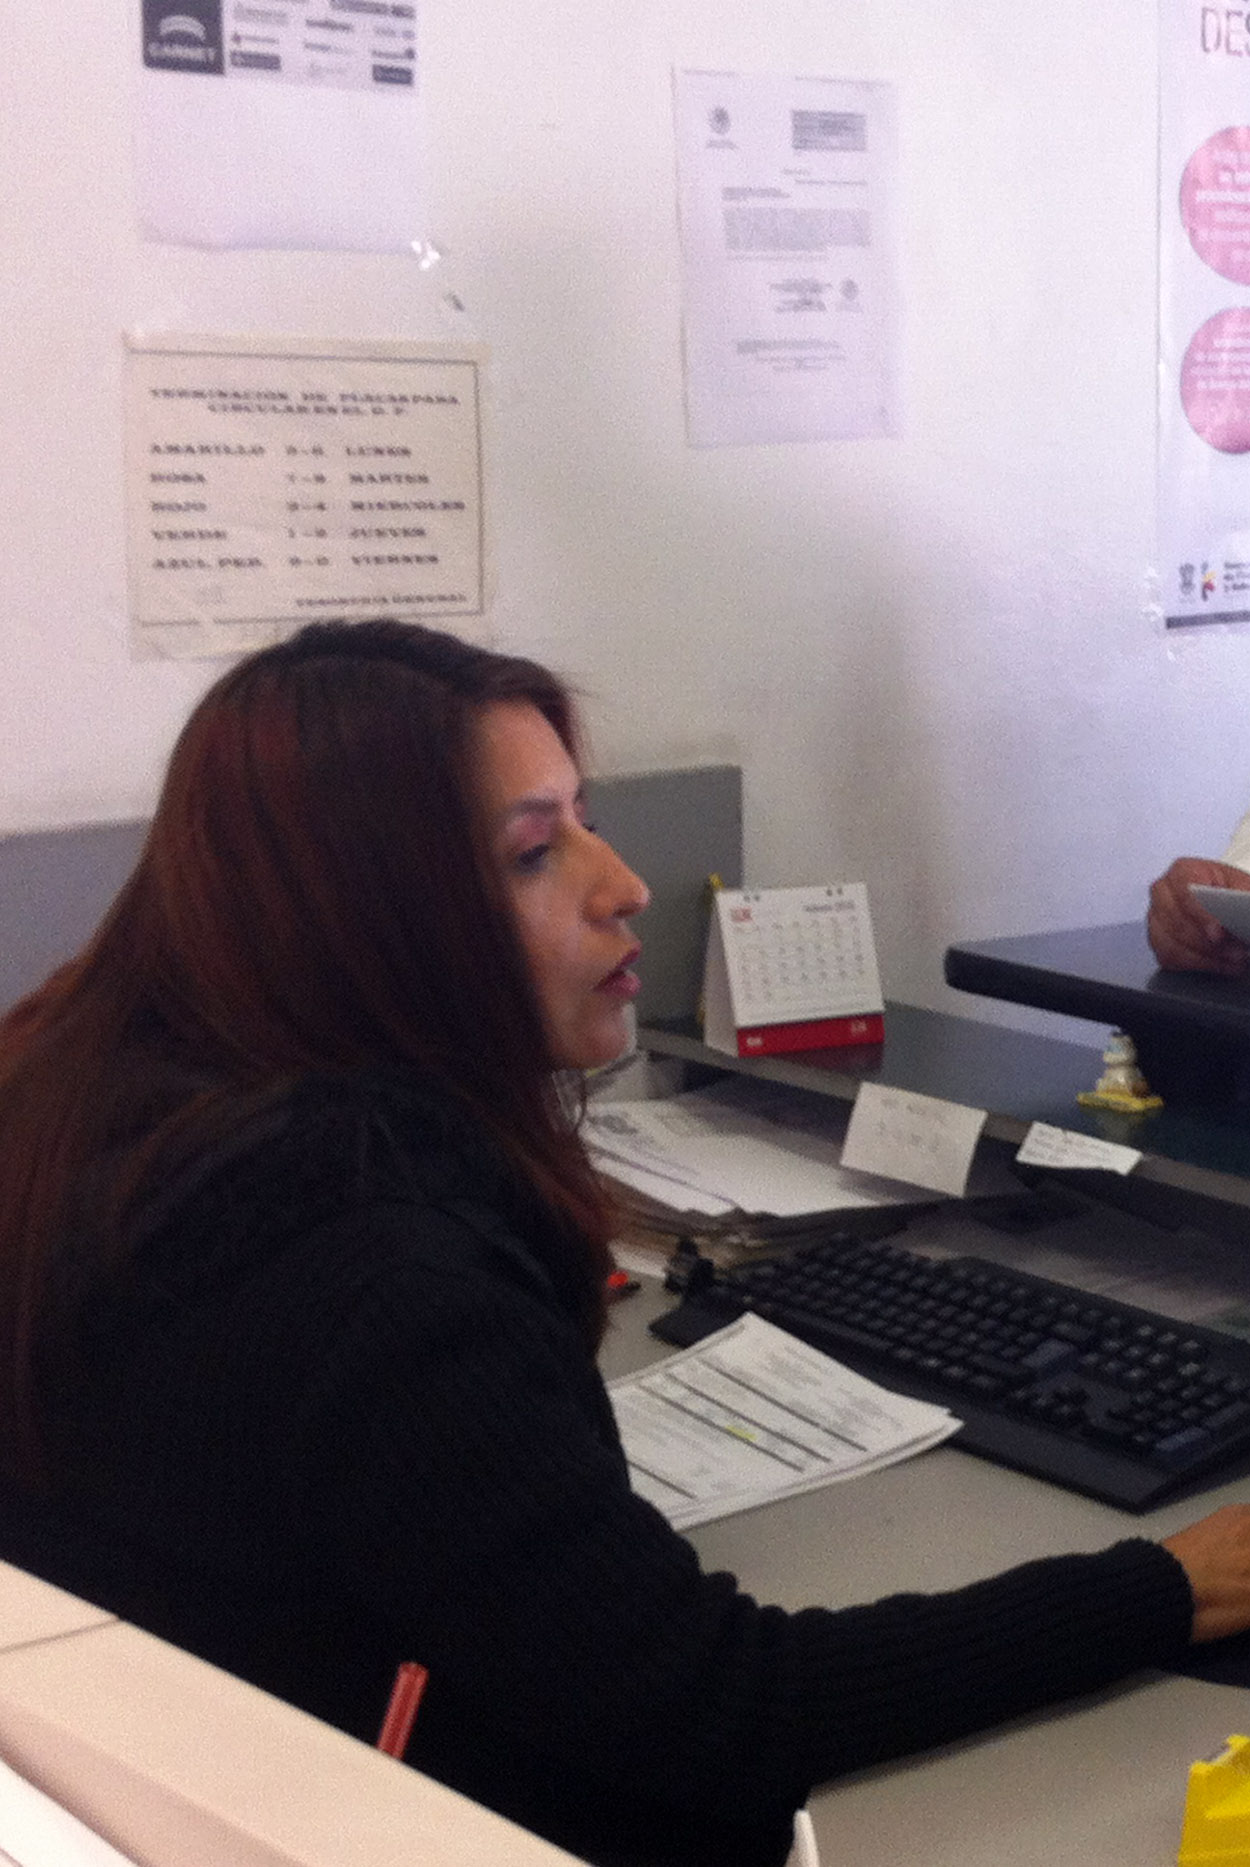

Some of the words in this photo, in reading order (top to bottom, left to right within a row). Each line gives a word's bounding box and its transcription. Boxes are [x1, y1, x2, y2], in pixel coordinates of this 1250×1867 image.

[152, 443, 265, 456] AMARILLO
[346, 445, 412, 457] LUNES
[350, 472, 430, 485] MARTES
[350, 500, 466, 512] MIERCOLES
[152, 529, 228, 541] VERDE
[350, 526, 427, 539] JUEVES
[352, 553, 440, 567] VIERNES
